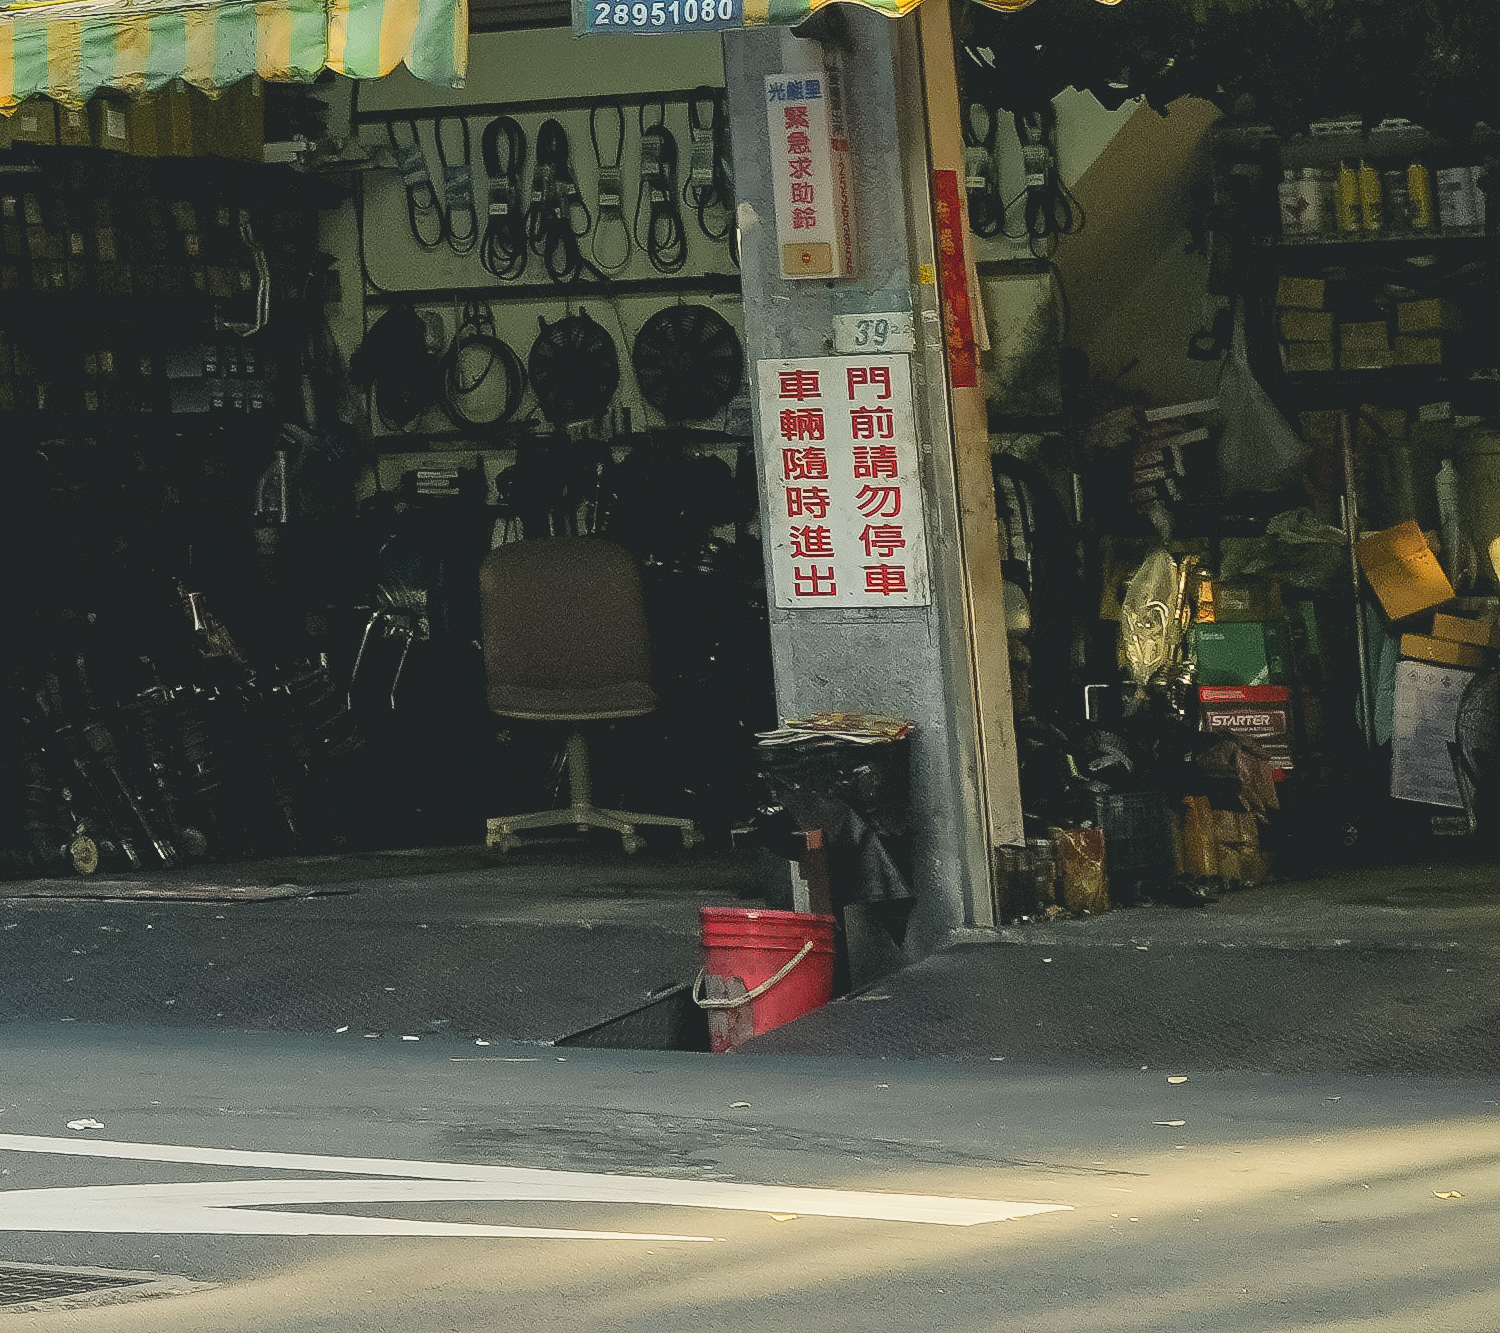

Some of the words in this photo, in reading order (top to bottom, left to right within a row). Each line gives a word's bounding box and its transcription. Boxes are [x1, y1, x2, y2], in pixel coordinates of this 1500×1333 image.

[778, 369, 837, 597] 車輛隨時進出
[846, 367, 908, 596] 門前請勿停車
[1211, 714, 1270, 727] STARTER
